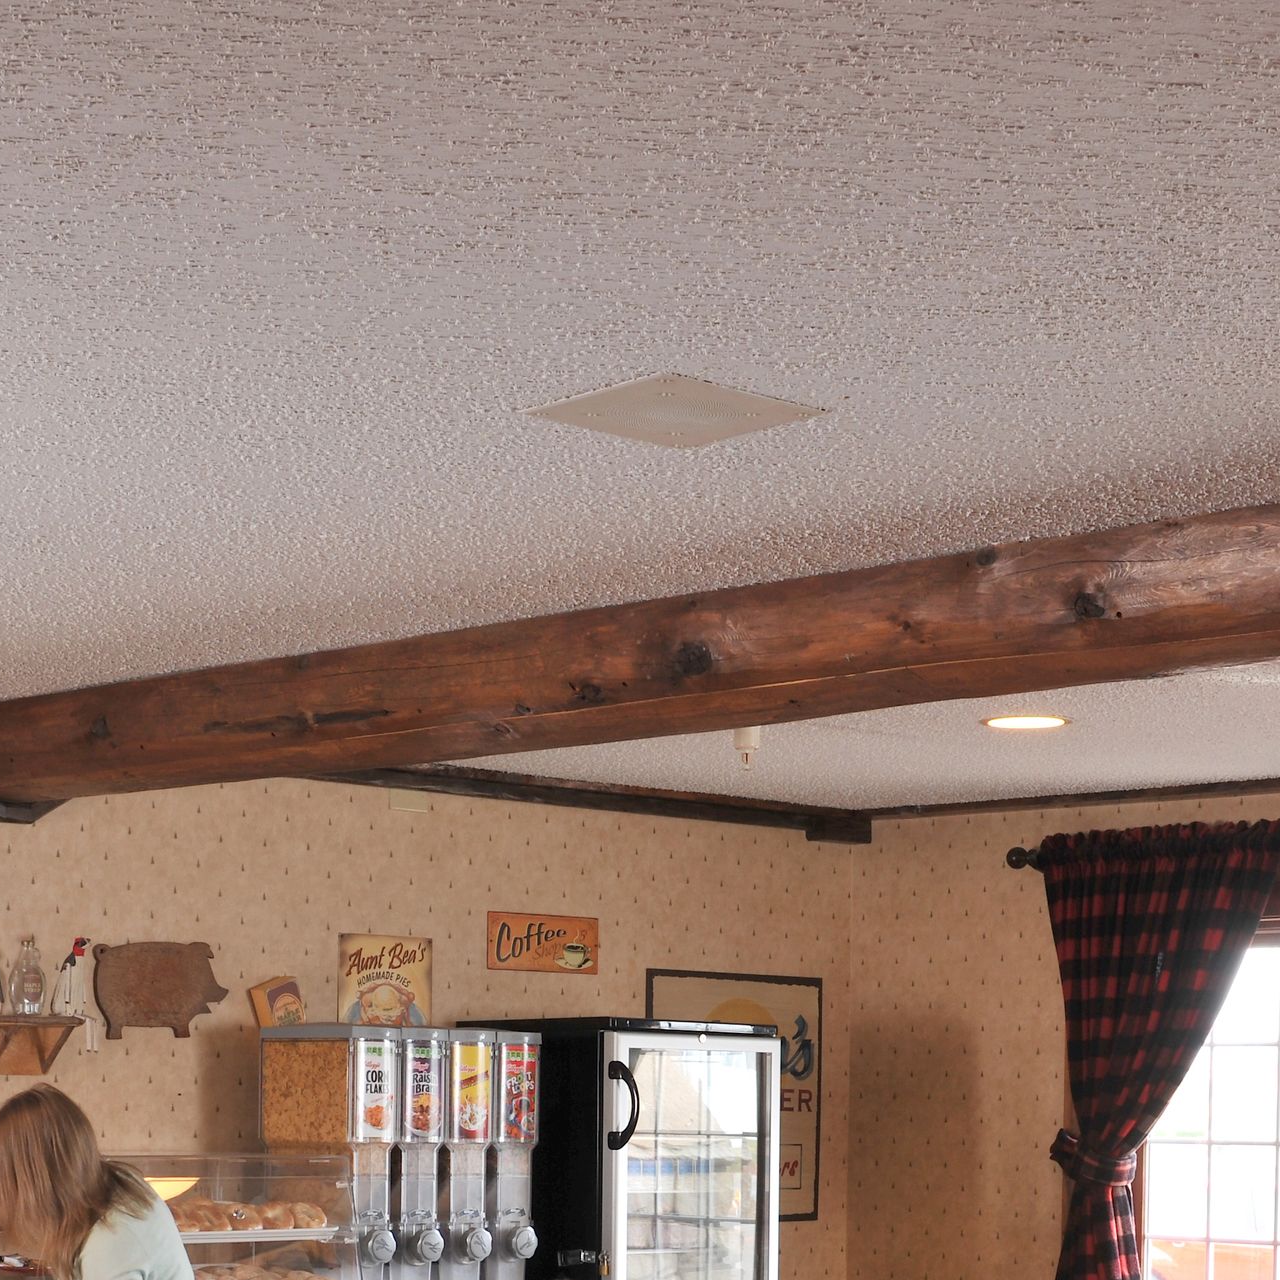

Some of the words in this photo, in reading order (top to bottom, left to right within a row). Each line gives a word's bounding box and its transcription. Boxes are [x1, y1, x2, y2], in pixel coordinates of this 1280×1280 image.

[496, 922, 567, 962] Coffee
[346, 946, 385, 977] Aunt
[389, 942, 426, 969] Bea's
[357, 971, 394, 988] HOMEMADE
[395, 973, 411, 988] PIES
[780, 1088, 813, 1112] ER
